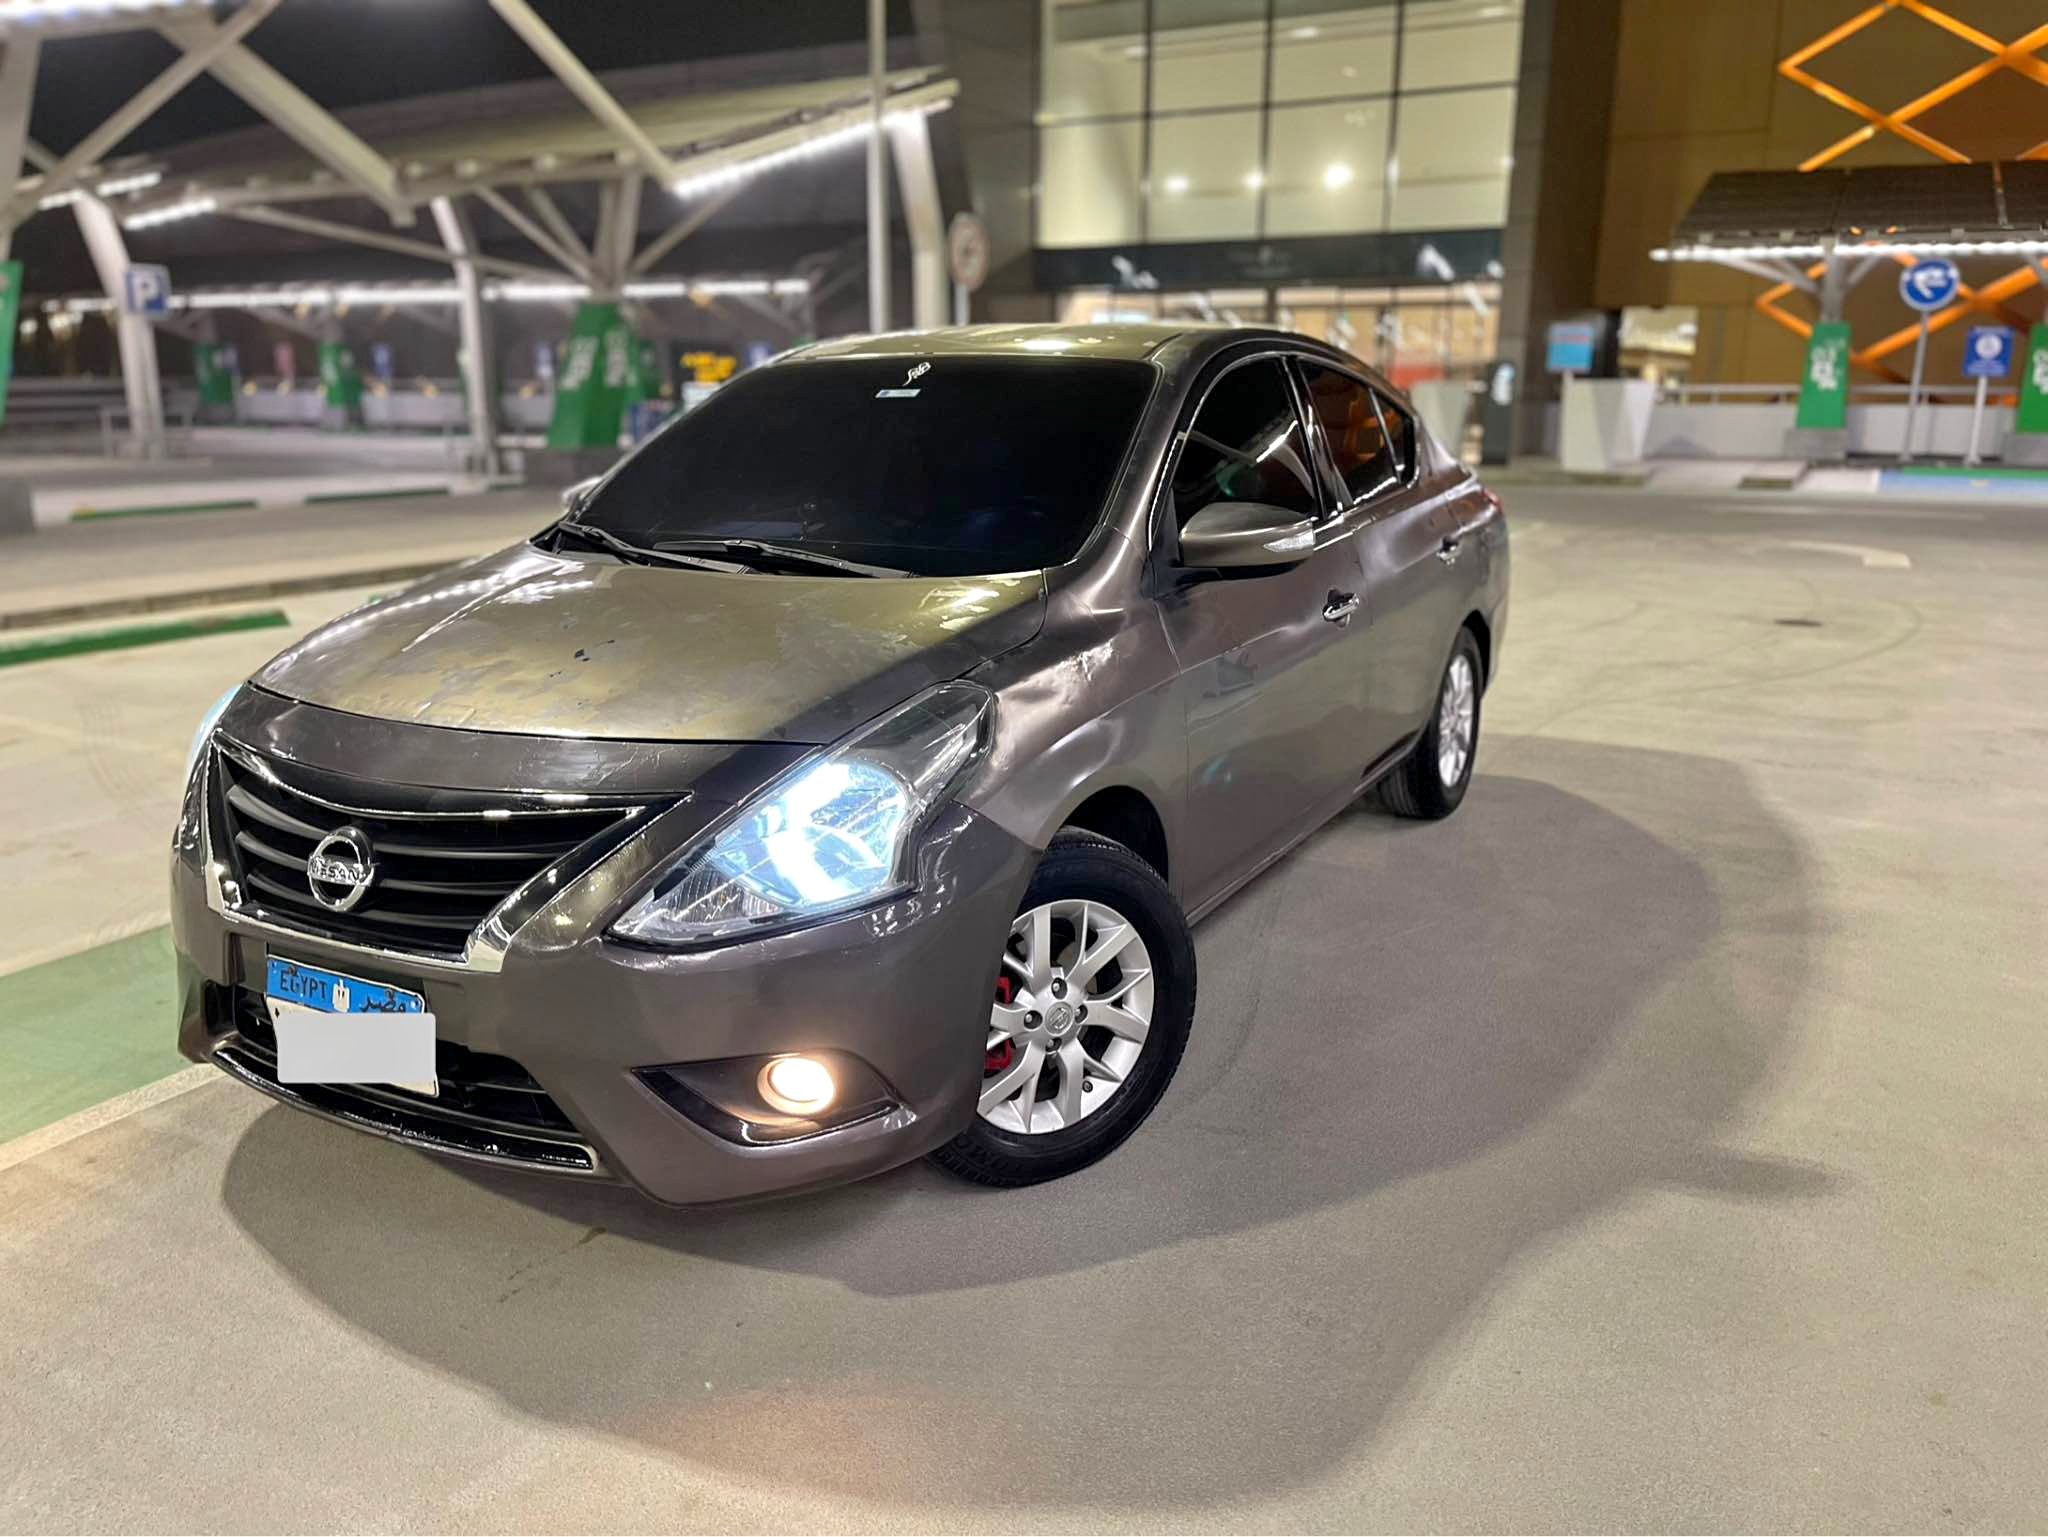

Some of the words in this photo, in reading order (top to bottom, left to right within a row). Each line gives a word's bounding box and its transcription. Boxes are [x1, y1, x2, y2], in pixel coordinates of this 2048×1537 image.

[131, 272, 159, 310] P
[279, 971, 327, 999] EGYPT
[359, 996, 406, 1013] مصر
